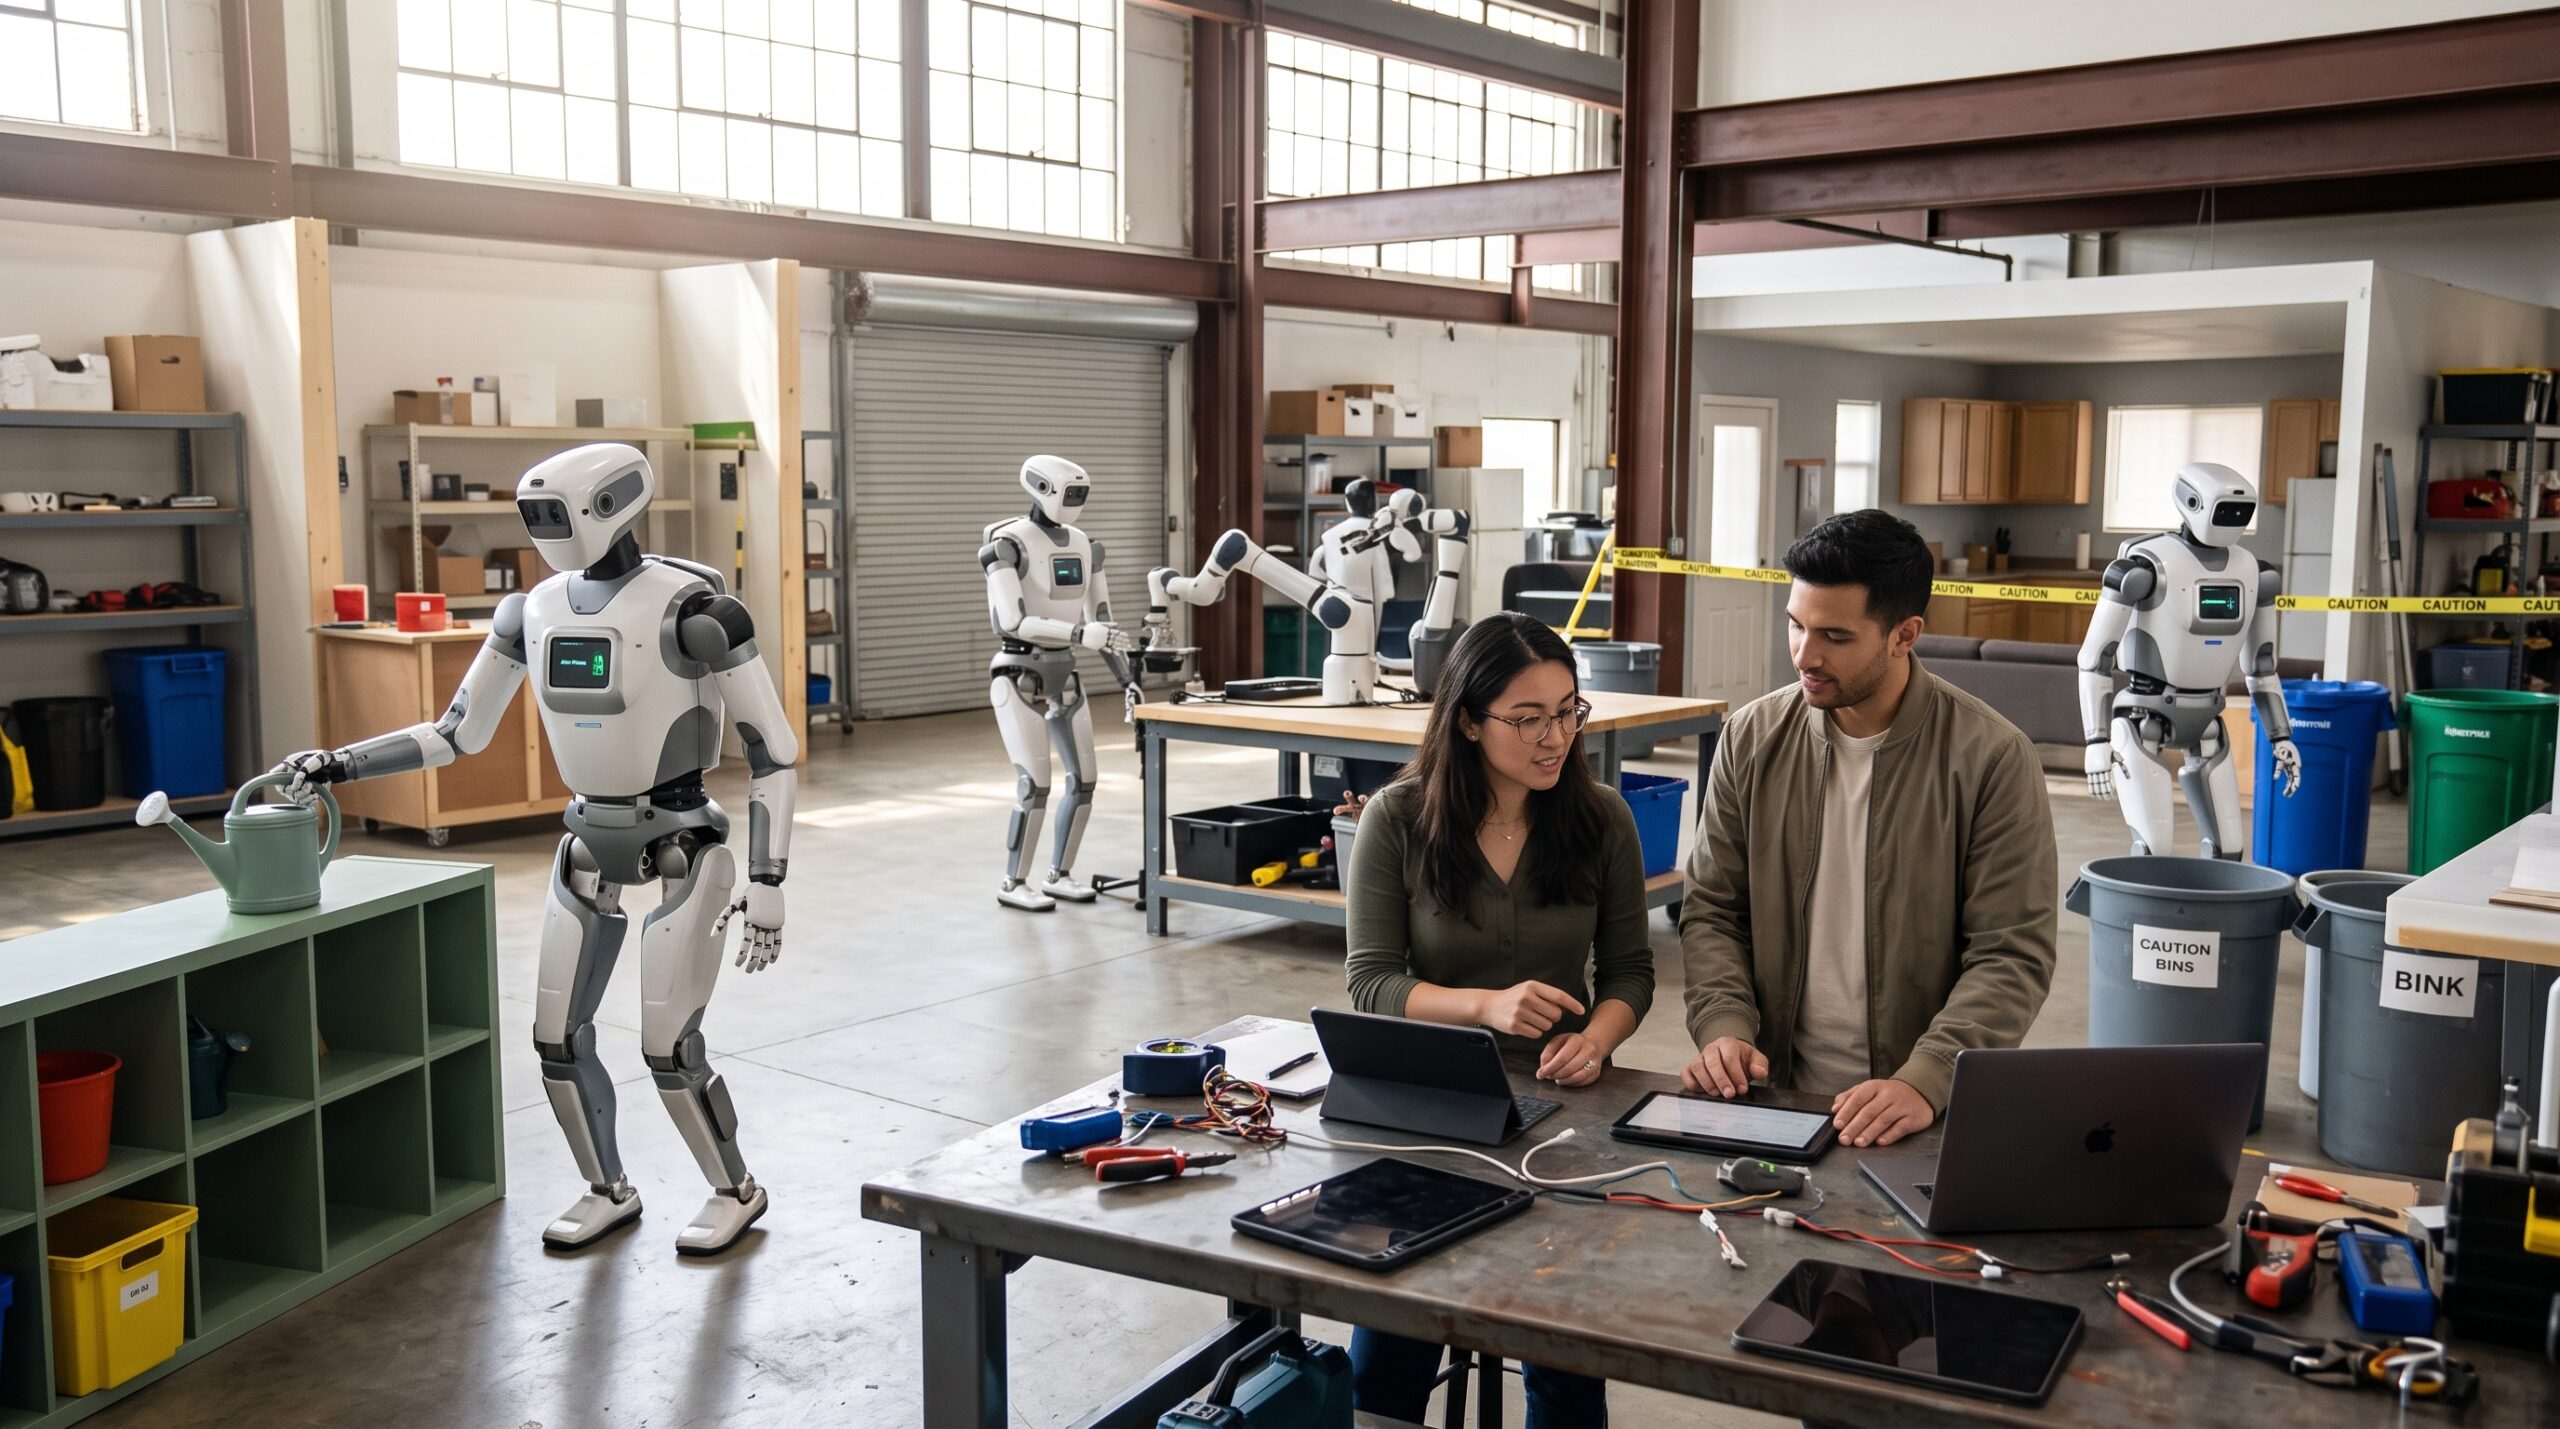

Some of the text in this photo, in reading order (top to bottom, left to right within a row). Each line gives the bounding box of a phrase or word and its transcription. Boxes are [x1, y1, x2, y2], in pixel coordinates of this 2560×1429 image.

[1681, 563, 1787, 580] CAUTION CAUTION
[1933, 583, 2048, 599] AUTION CAUTION
[2327, 598, 2560, 611] CAUTION CAUTION CAUT
[2140, 938, 2211, 956] CAUTION
[2155, 958, 2195, 973] BINS
[2395, 969, 2465, 998] BINK
